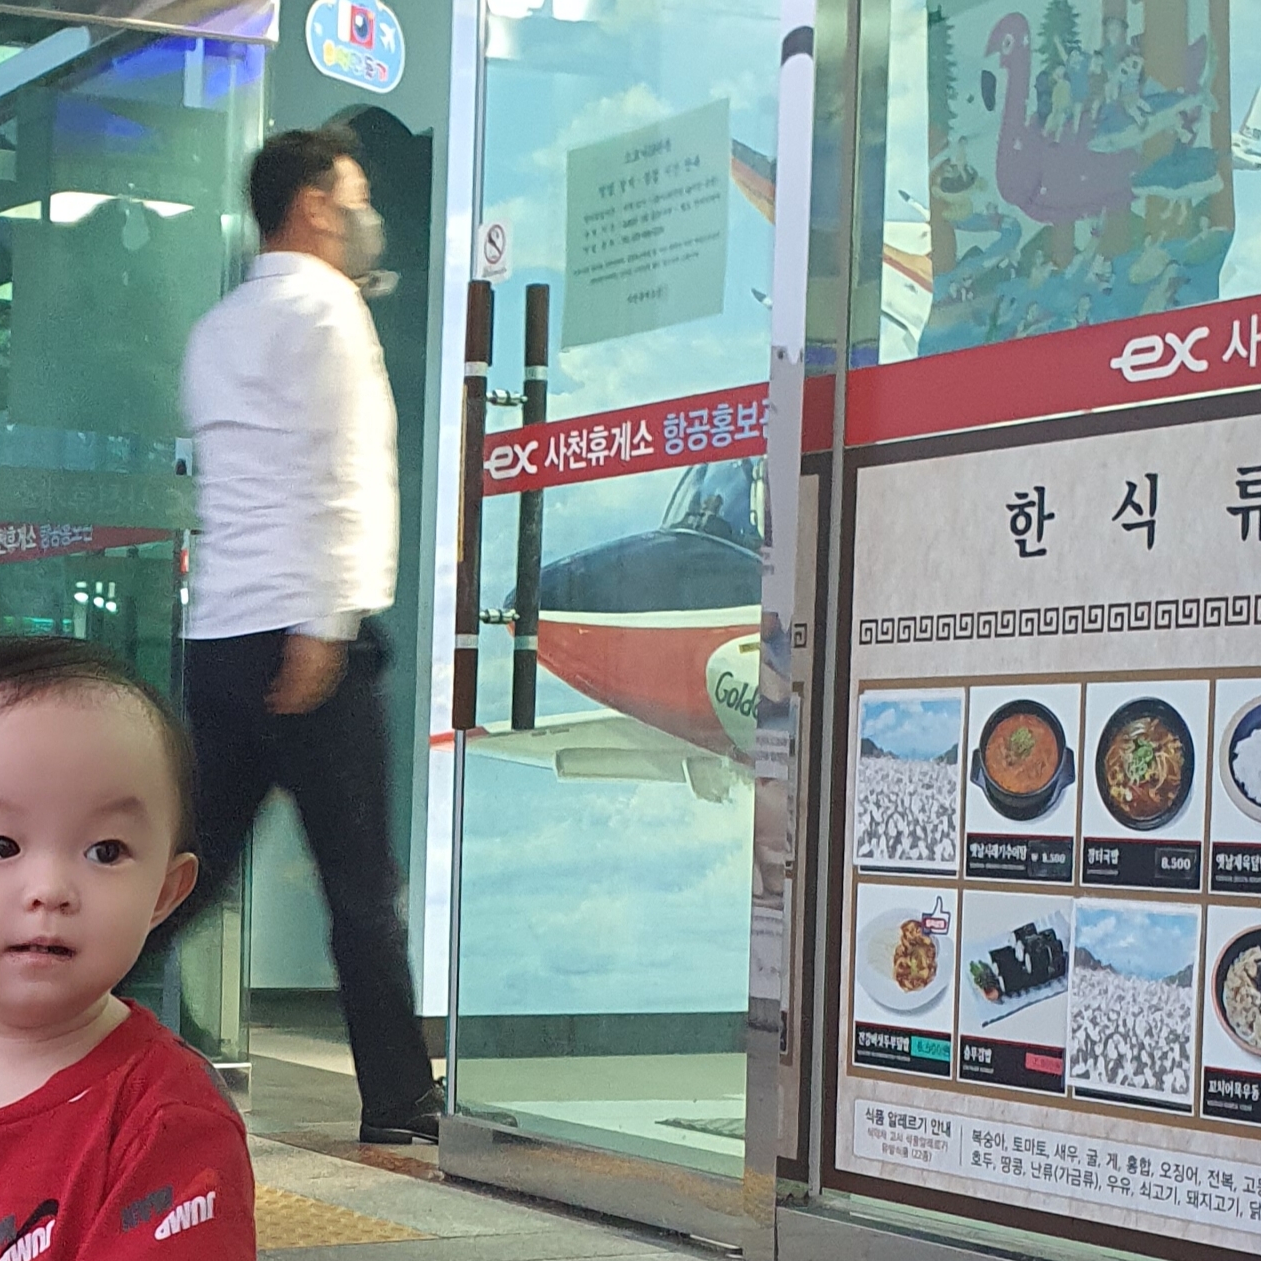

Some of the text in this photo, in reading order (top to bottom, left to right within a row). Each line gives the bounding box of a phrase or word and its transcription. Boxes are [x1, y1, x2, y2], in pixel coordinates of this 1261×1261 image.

[1110, 326, 1210, 383] ex
[484, 440, 539, 480] ex
[544, 419, 655, 473] 사천휴게소
[1005, 485, 1056, 559] 한
[1111, 472, 1159, 551] 식
[715, 671, 759, 720] Gold
[1215, 852, 1261, 873] 옛날제육덮
[865, 1107, 952, 1138] 식품 알레르기 안내
[971, 1129, 1008, 1152] 복숭아,
[1012, 1136, 1050, 1159] 토마토,
[1054, 1143, 1081, 1165] 새우,
[1086, 1149, 1101, 1168] 굴,
[1106, 1152, 1121, 1172] 게,
[1126, 1155, 1154, 1178] 홍합,
[1159, 1161, 1202, 1186] 오징어,
[1207, 1169, 1237, 1193] 전복,
[971, 1150, 997, 1170] 호두,
[1000, 1156, 1026, 1177] 땅콩,
[1031, 1159, 1102, 1191] 난류(가금류),
[1107, 1175, 1134, 1197] 우유,
[1139, 1181, 1180, 1206] 쇠고기,
[1186, 1189, 1243, 1218] 돼지고기,
[154, 1189, 216, 1241] JUMP
